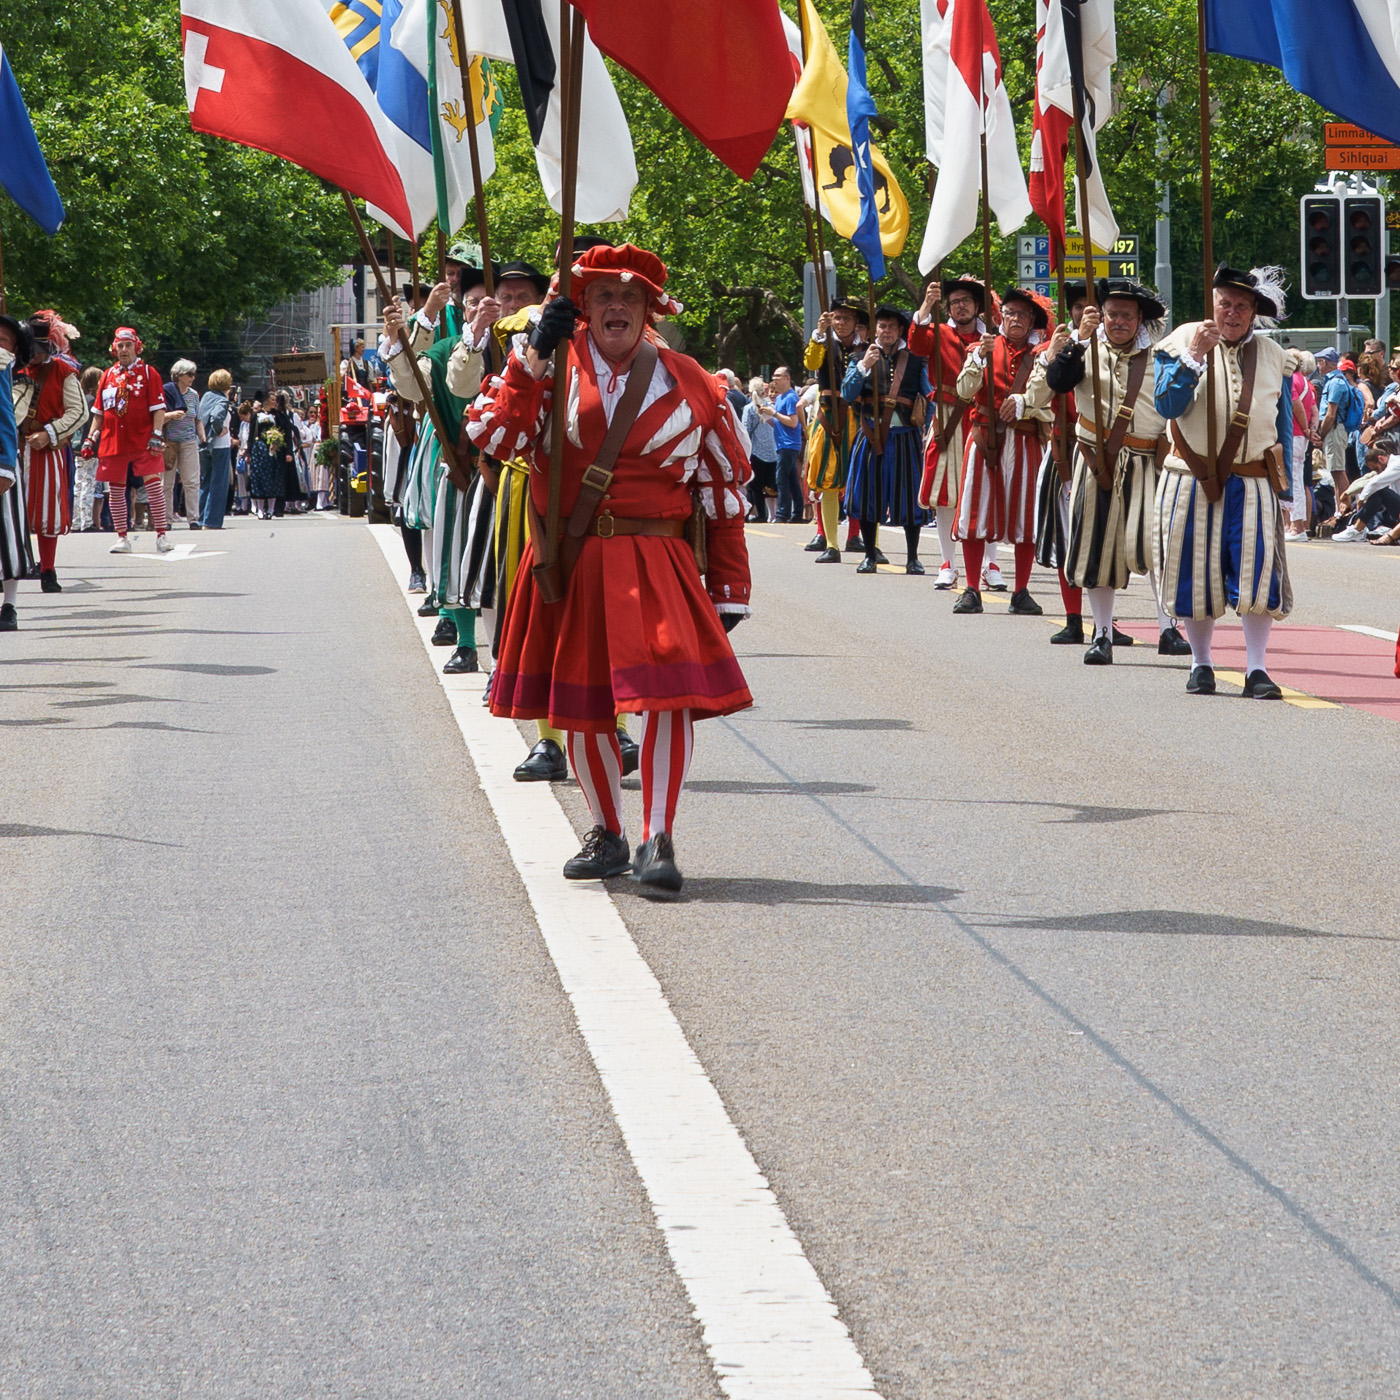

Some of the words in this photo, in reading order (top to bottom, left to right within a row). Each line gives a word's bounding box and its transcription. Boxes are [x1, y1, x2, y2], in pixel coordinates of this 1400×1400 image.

[1328, 127, 1376, 140] Limmatp
[1339, 151, 1388, 166] Sihlquai
[1113, 240, 1134, 253] 197
[1119, 263, 1135, 276] 11
